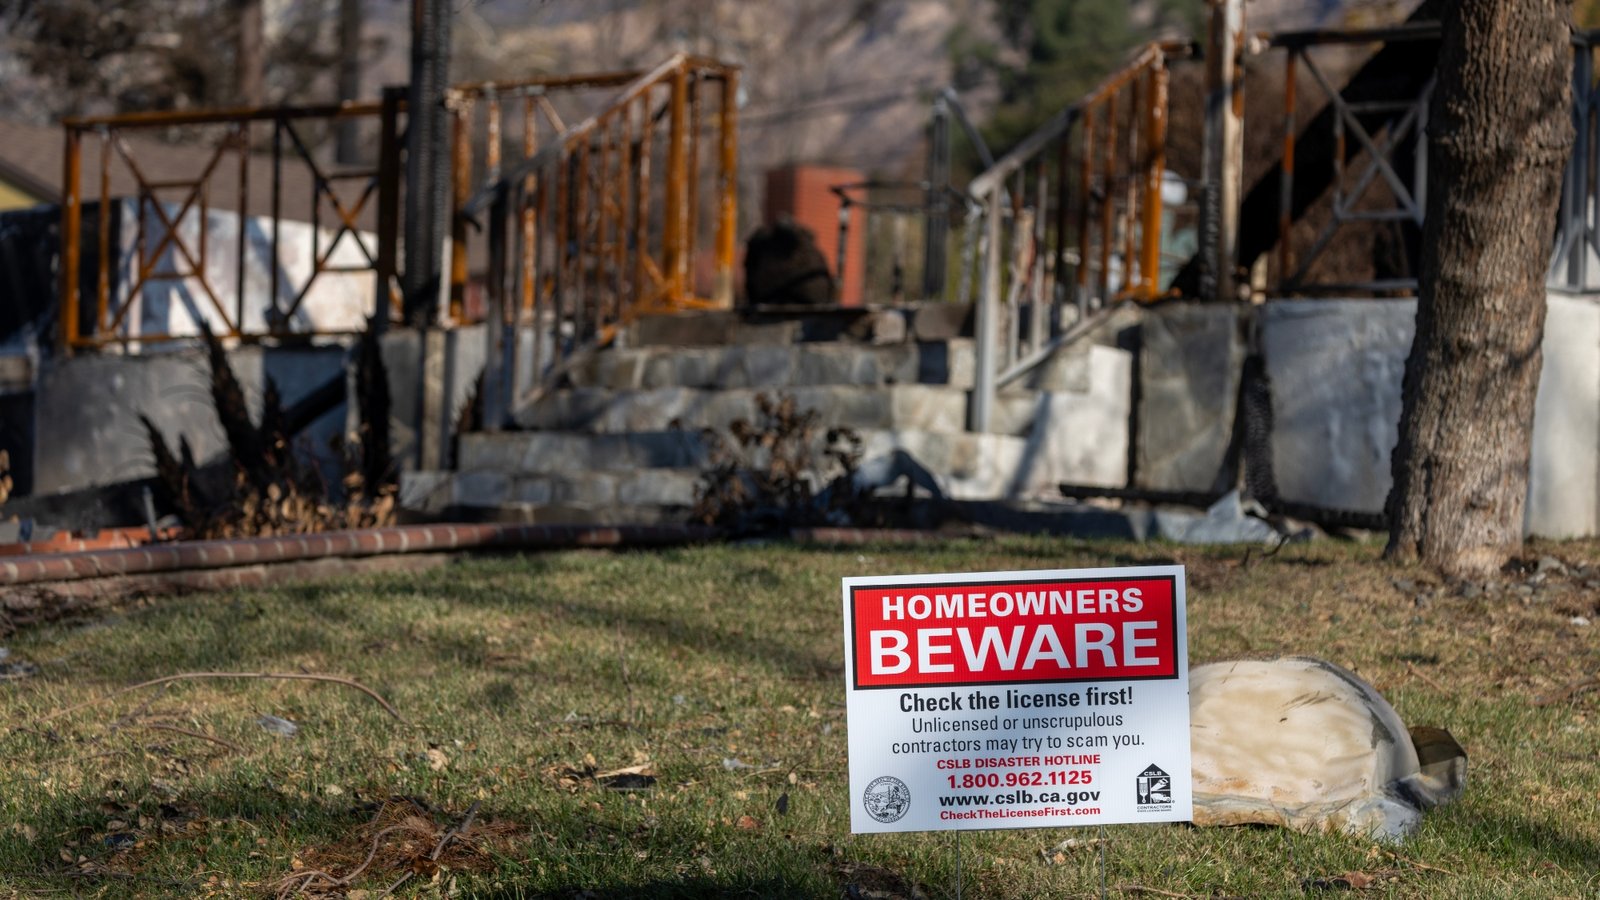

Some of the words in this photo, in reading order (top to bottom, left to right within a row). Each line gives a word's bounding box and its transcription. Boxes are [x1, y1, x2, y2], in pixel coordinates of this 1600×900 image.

[882, 587, 1144, 621] HOMEOWNERS
[869, 621, 1160, 674] BEWARE
[900, 693, 962, 712] Check
[968, 691, 999, 710] the
[1007, 690, 1080, 708] license
[1086, 687, 1133, 706] first!
[912, 716, 998, 733] Unlicensed
[1003, 718, 1018, 729] or
[1023, 712, 1123, 730] unscrupulous
[892, 739, 981, 753] contractors
[986, 739, 1017, 753] may
[1023, 737, 1042, 752] try
[1047, 736, 1061, 748] to
[1067, 735, 1108, 747] scam
[1113, 733, 1145, 748] you.
[937, 758, 970, 770] CSLB
[975, 757, 1040, 768] DISASTER
[1045, 754, 1100, 765] HOTLINE
[947, 770, 1092, 789] 1.800.962.1125
[939, 789, 1100, 806] www.cslb.ca.gov
[940, 807, 1100, 820] CheckTheLicenseFirst.com
